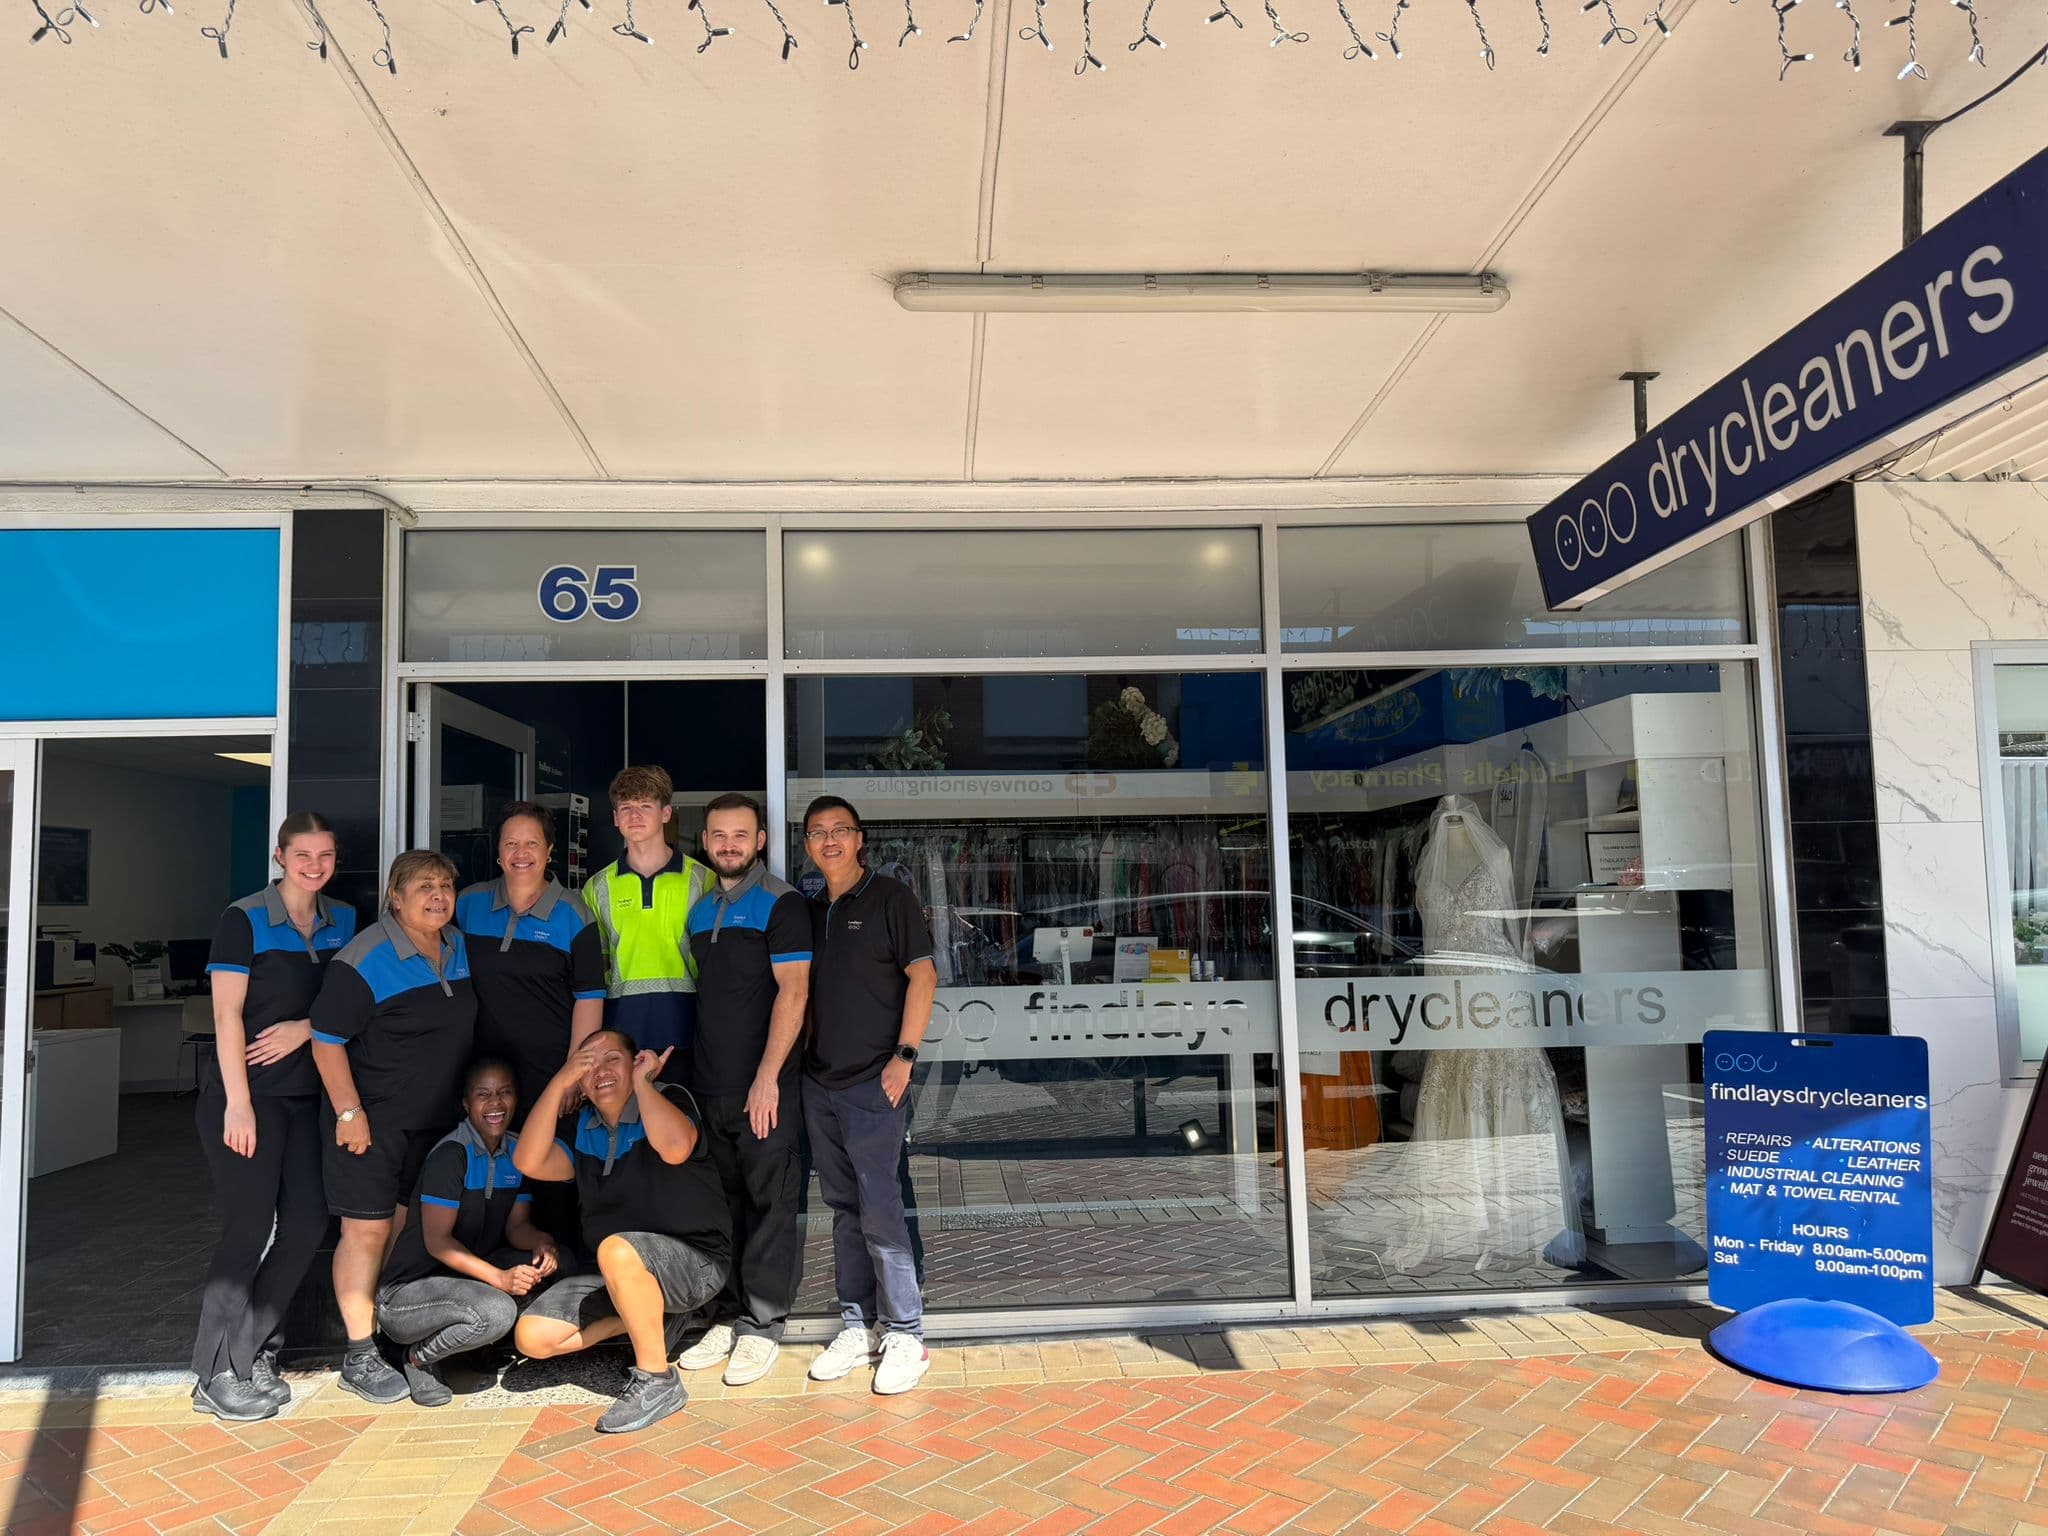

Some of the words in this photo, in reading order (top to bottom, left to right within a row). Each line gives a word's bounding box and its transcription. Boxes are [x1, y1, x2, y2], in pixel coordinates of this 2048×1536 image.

[1647, 244, 2015, 518] drycleaners
[537, 563, 642, 623] 65
[1023, 990, 1250, 1050] findlays
[1323, 979, 1667, 1045] drycleaners
[1710, 1082, 1928, 1110] findlaysdrycleaners
[1725, 1132, 1792, 1147] REPAIRS
[1811, 1137, 1921, 1154] ALTERATIONS
[1726, 1149, 1780, 1163] SUEDE
[1847, 1156, 1921, 1172] LEATHER
[1726, 1165, 1819, 1183] INDUSTRIAL
[1821, 1172, 1904, 1188] CLEANING
[1730, 1183, 1762, 1197] MAT
[1766, 1184, 1777, 1197] &
[1783, 1185, 1836, 1201] TOWEL
[1839, 1189, 1901, 1205] RENTAL
[1792, 1223, 1849, 1239] HOURS
[1713, 1235, 1744, 1250] Mon
[1759, 1238, 1804, 1256] Friday
[1812, 1243, 1928, 1265] 8.00am-5.00pm
[1714, 1251, 1739, 1265] Sat
